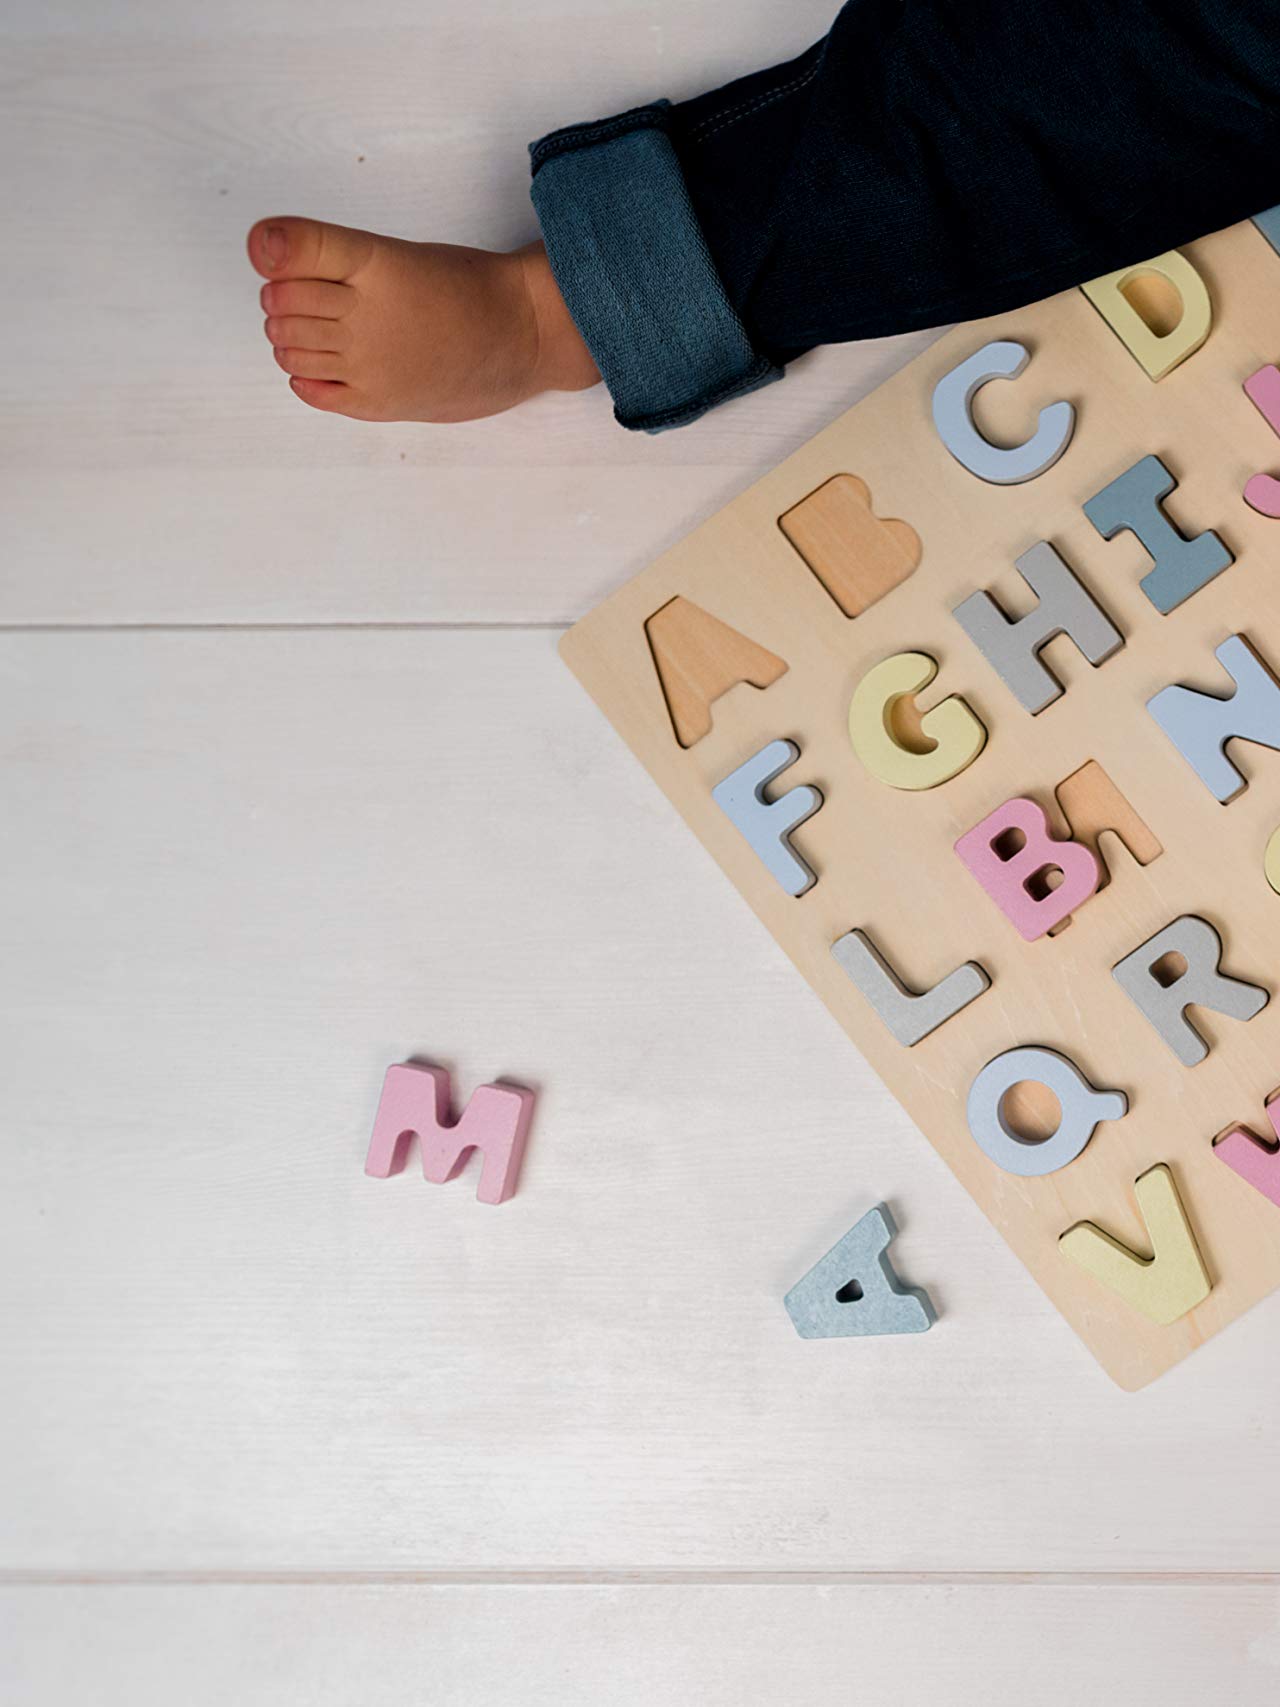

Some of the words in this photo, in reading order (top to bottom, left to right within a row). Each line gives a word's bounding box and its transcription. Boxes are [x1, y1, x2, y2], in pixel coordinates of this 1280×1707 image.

[932, 341, 1076, 485] C
[1079, 249, 1212, 382] D
[711, 738, 825, 897] F
[849, 651, 988, 790] G
[951, 540, 1126, 716] H
[1081, 454, 1235, 615] I
[830, 928, 992, 1047] L
[953, 797, 1099, 942] B
[365, 1057, 536, 1205] M
[967, 1043, 1129, 1177] Q
[1111, 914, 1270, 1067] R
[785, 1201, 939, 1340] A
[1058, 1162, 1213, 1326] V
